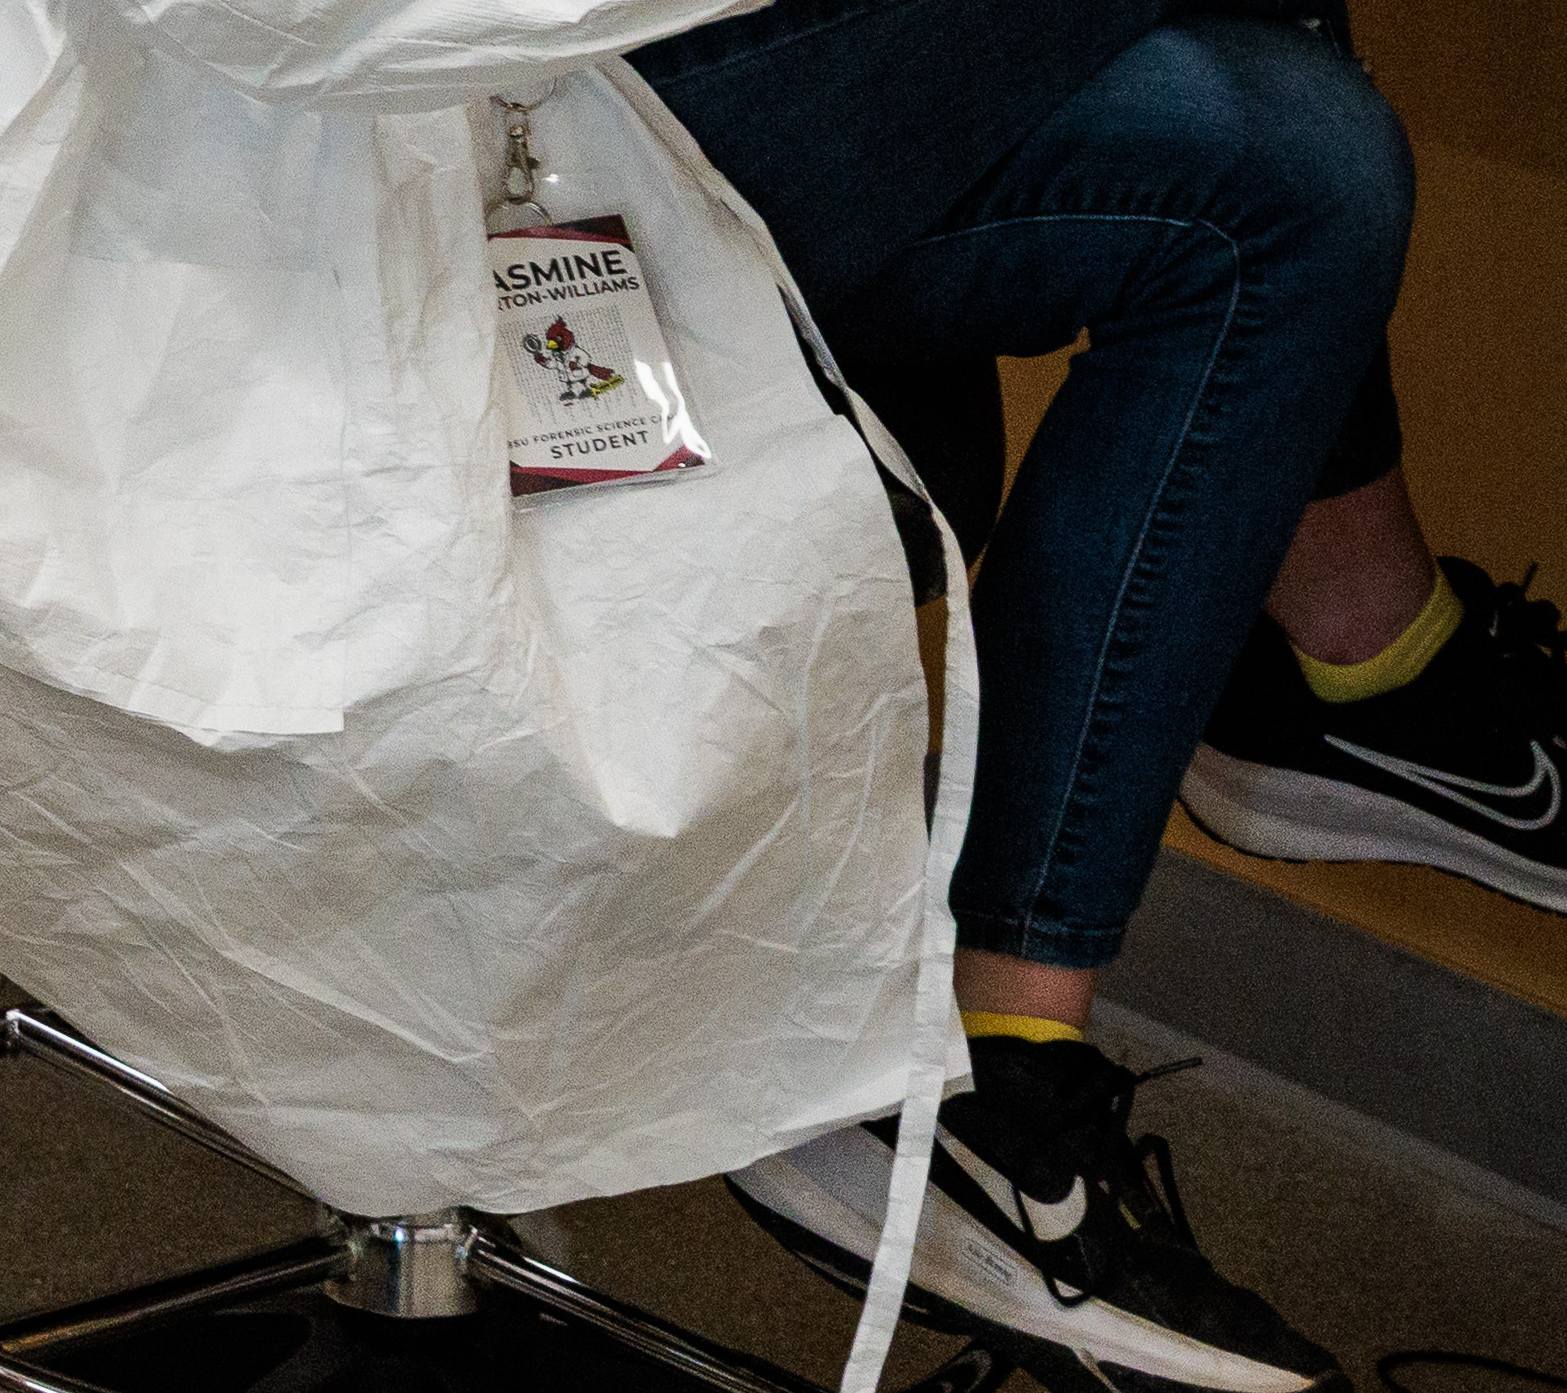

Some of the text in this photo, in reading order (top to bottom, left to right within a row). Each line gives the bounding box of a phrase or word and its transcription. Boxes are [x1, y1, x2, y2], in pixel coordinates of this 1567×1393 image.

[493, 249, 628, 292] ASMINE
[533, 426, 593, 444] FORENSIC
[596, 417, 647, 433] SCIENCE
[550, 429, 650, 460] STUDENT
